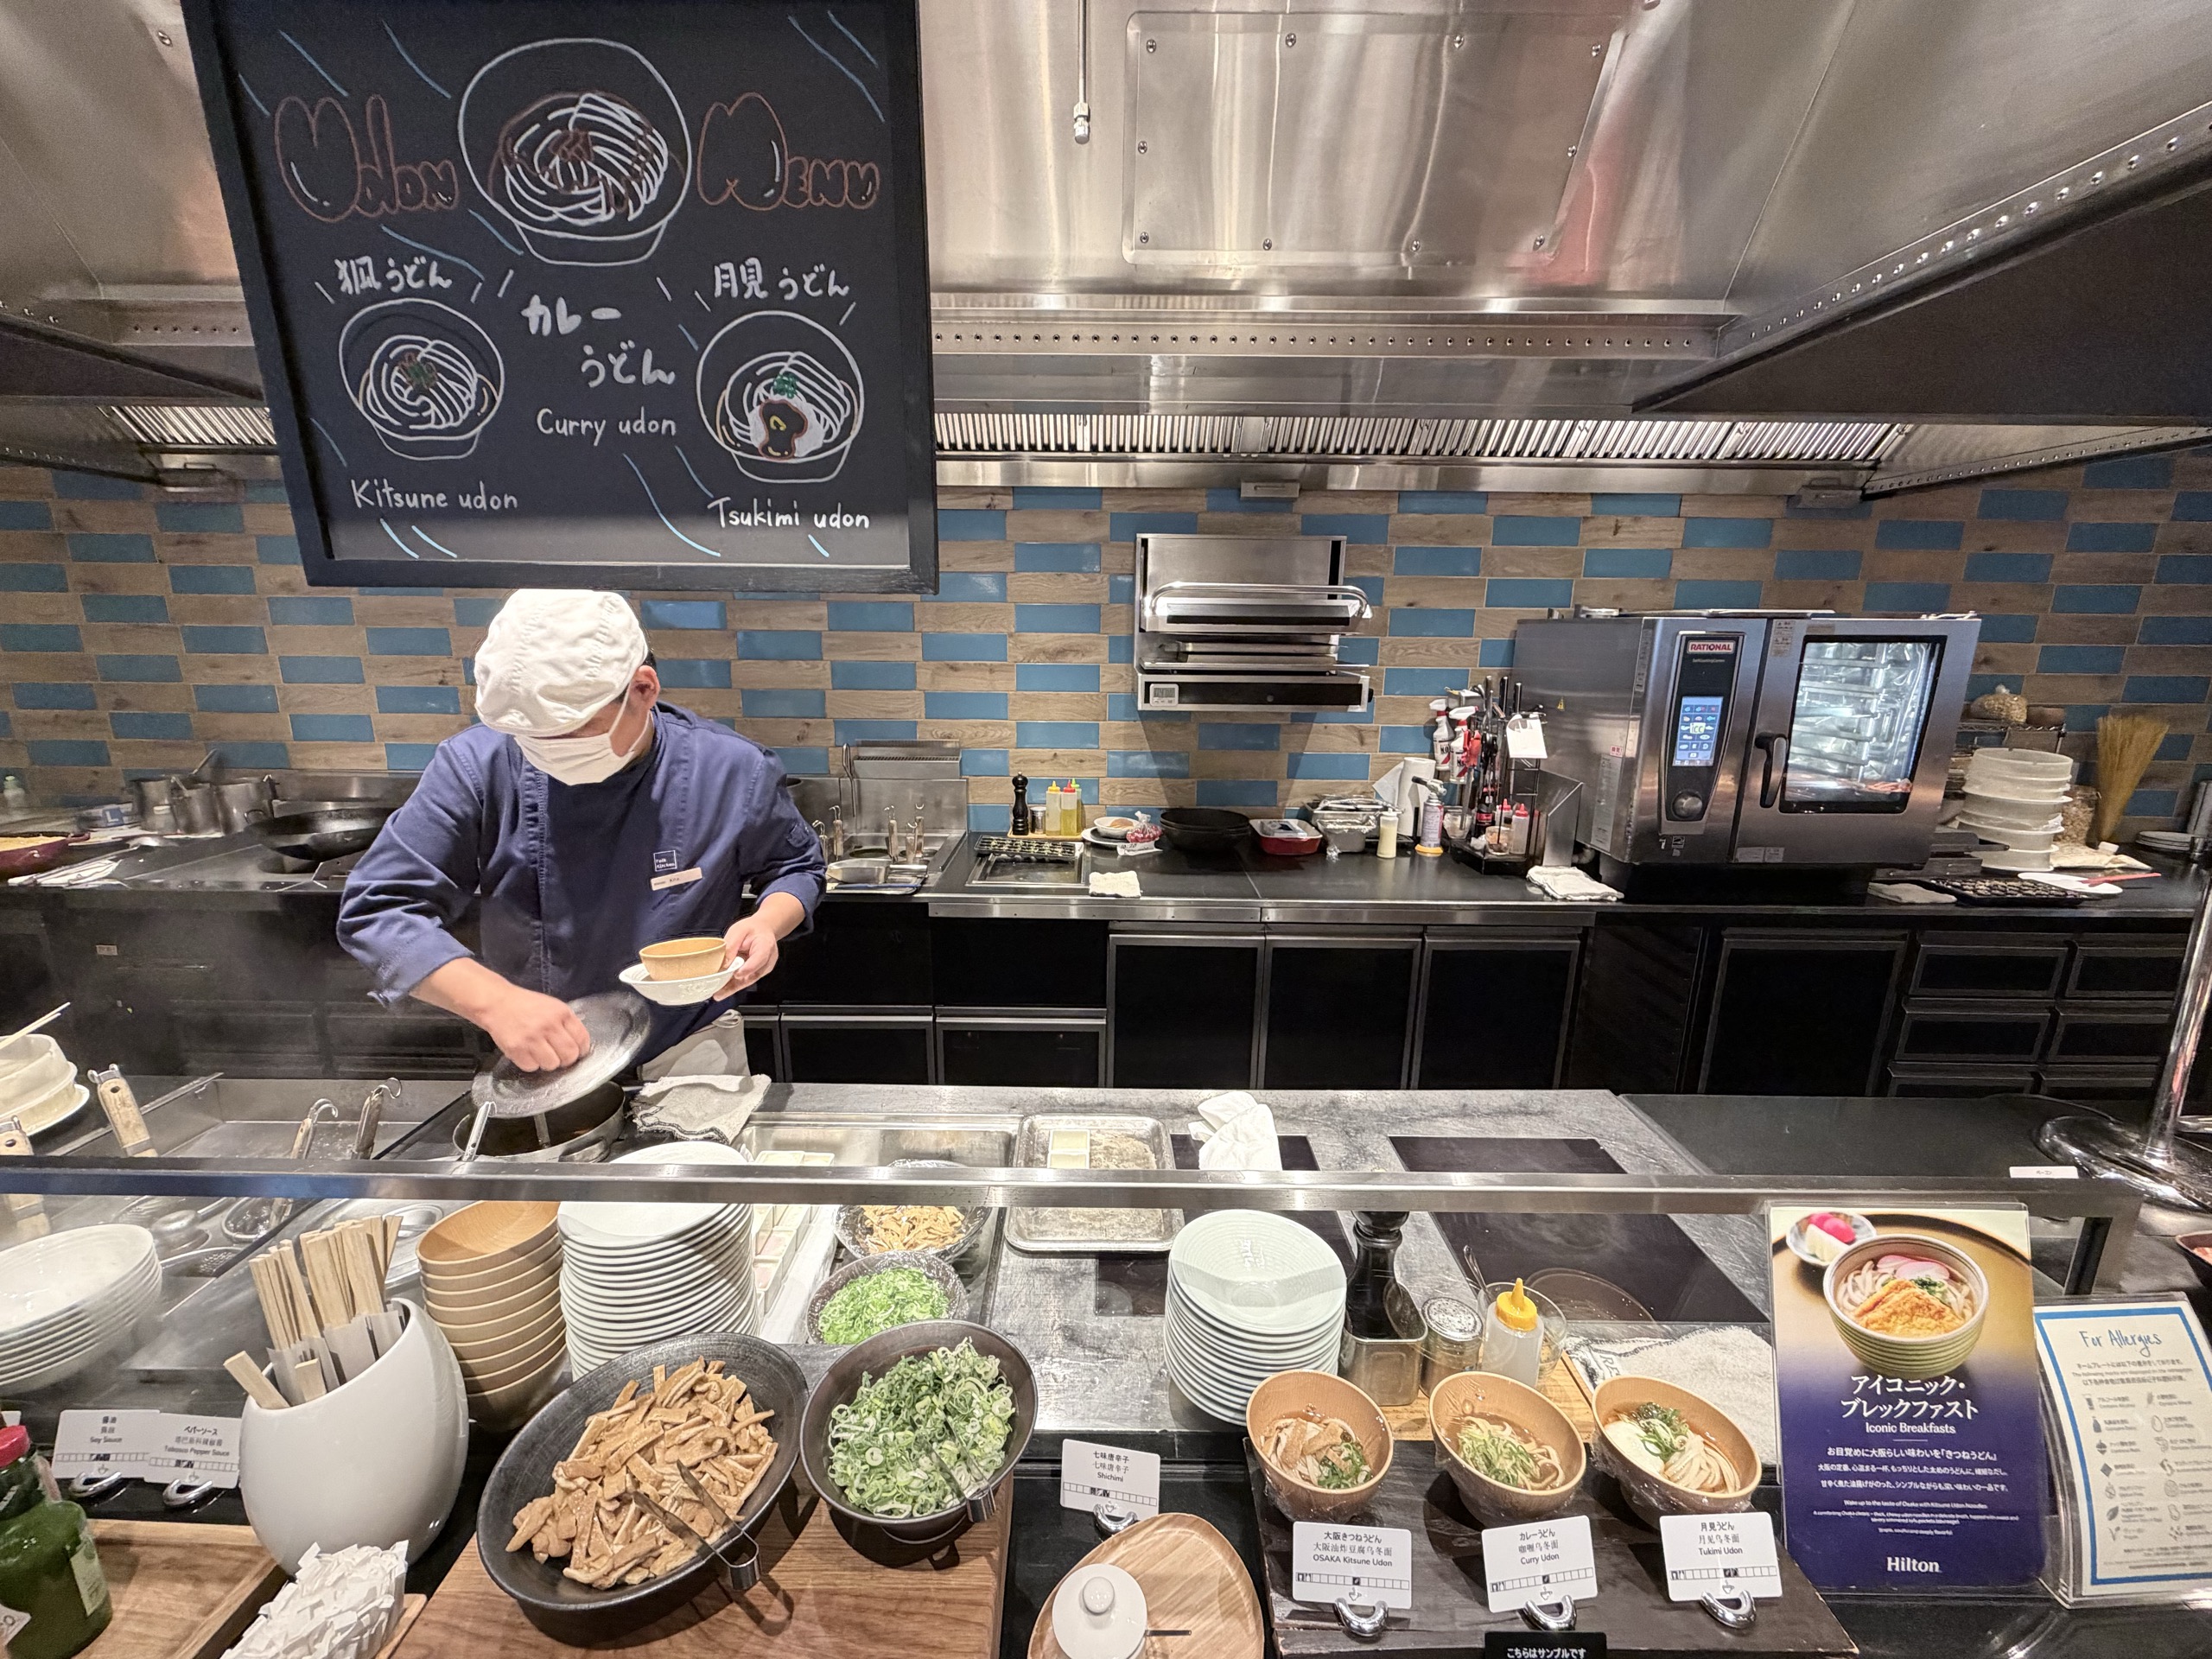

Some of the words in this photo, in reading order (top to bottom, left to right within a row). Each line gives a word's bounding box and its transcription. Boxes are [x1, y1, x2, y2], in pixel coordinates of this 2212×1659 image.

[520, 295, 622, 337] カレー
[581, 339, 677, 389] うどん
[537, 407, 607, 447] Curry
[618, 405, 677, 436] udon
[350, 478, 449, 509] Kitsune
[458, 480, 518, 512] udon
[707, 496, 800, 529] Tsukimi
[813, 502, 871, 530] udon
[1690, 643, 1732, 652] RATIONAL
[2079, 1331, 2102, 1348] For
[2108, 1329, 2162, 1357] Allergies
[1840, 1396, 1979, 1420] ブレックファスト
[1866, 1422, 1897, 1433] Iconic
[1899, 1422, 1956, 1434] Breakfasts
[1093, 1451, 1129, 1464] 七味唐辛子
[1097, 1471, 1124, 1483] Shichimi
[1700, 1521, 1735, 1532] 月見うどん
[1324, 1531, 1382, 1544] 大阪きつねうどん
[1519, 1529, 1555, 1541] カレーうどん
[1699, 1547, 1722, 1556] Tukimi
[1723, 1546, 1743, 1555] Udon
[1313, 1554, 1341, 1563] OSAKA
[1343, 1555, 1370, 1566] Kitsune
[1372, 1558, 1393, 1567] Udon
[1521, 1556, 1540, 1565] Curry
[1541, 1553, 1560, 1562] Udon
[1886, 1556, 1941, 1573] Hilton
[1506, 1647, 1586, 1659] こちらはサンプルです
